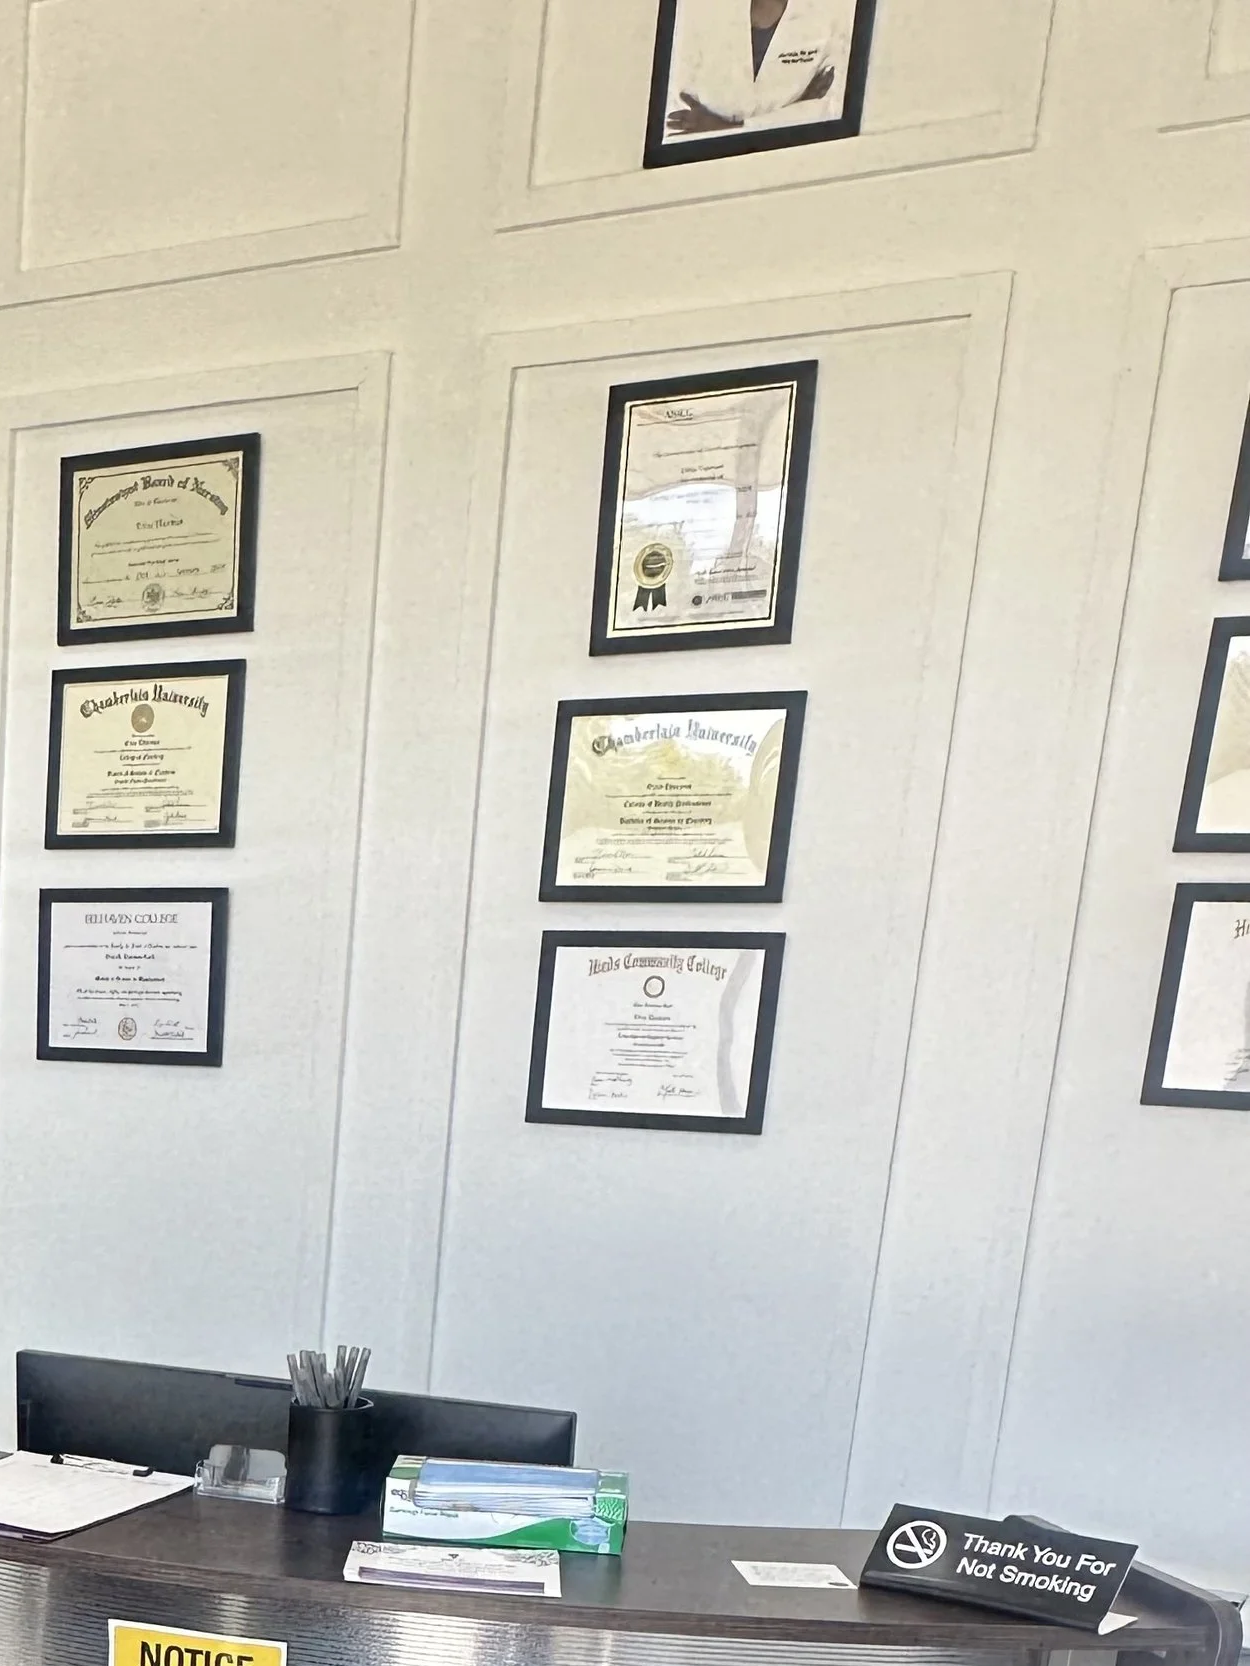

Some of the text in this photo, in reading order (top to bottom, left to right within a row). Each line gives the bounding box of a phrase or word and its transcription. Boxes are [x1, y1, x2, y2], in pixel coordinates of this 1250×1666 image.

[152, 683, 210, 719] University
[591, 718, 758, 757] Chamberlain University
[963, 1532, 1117, 1577] Thank You For
[955, 1556, 1097, 1603] Not Smoking
